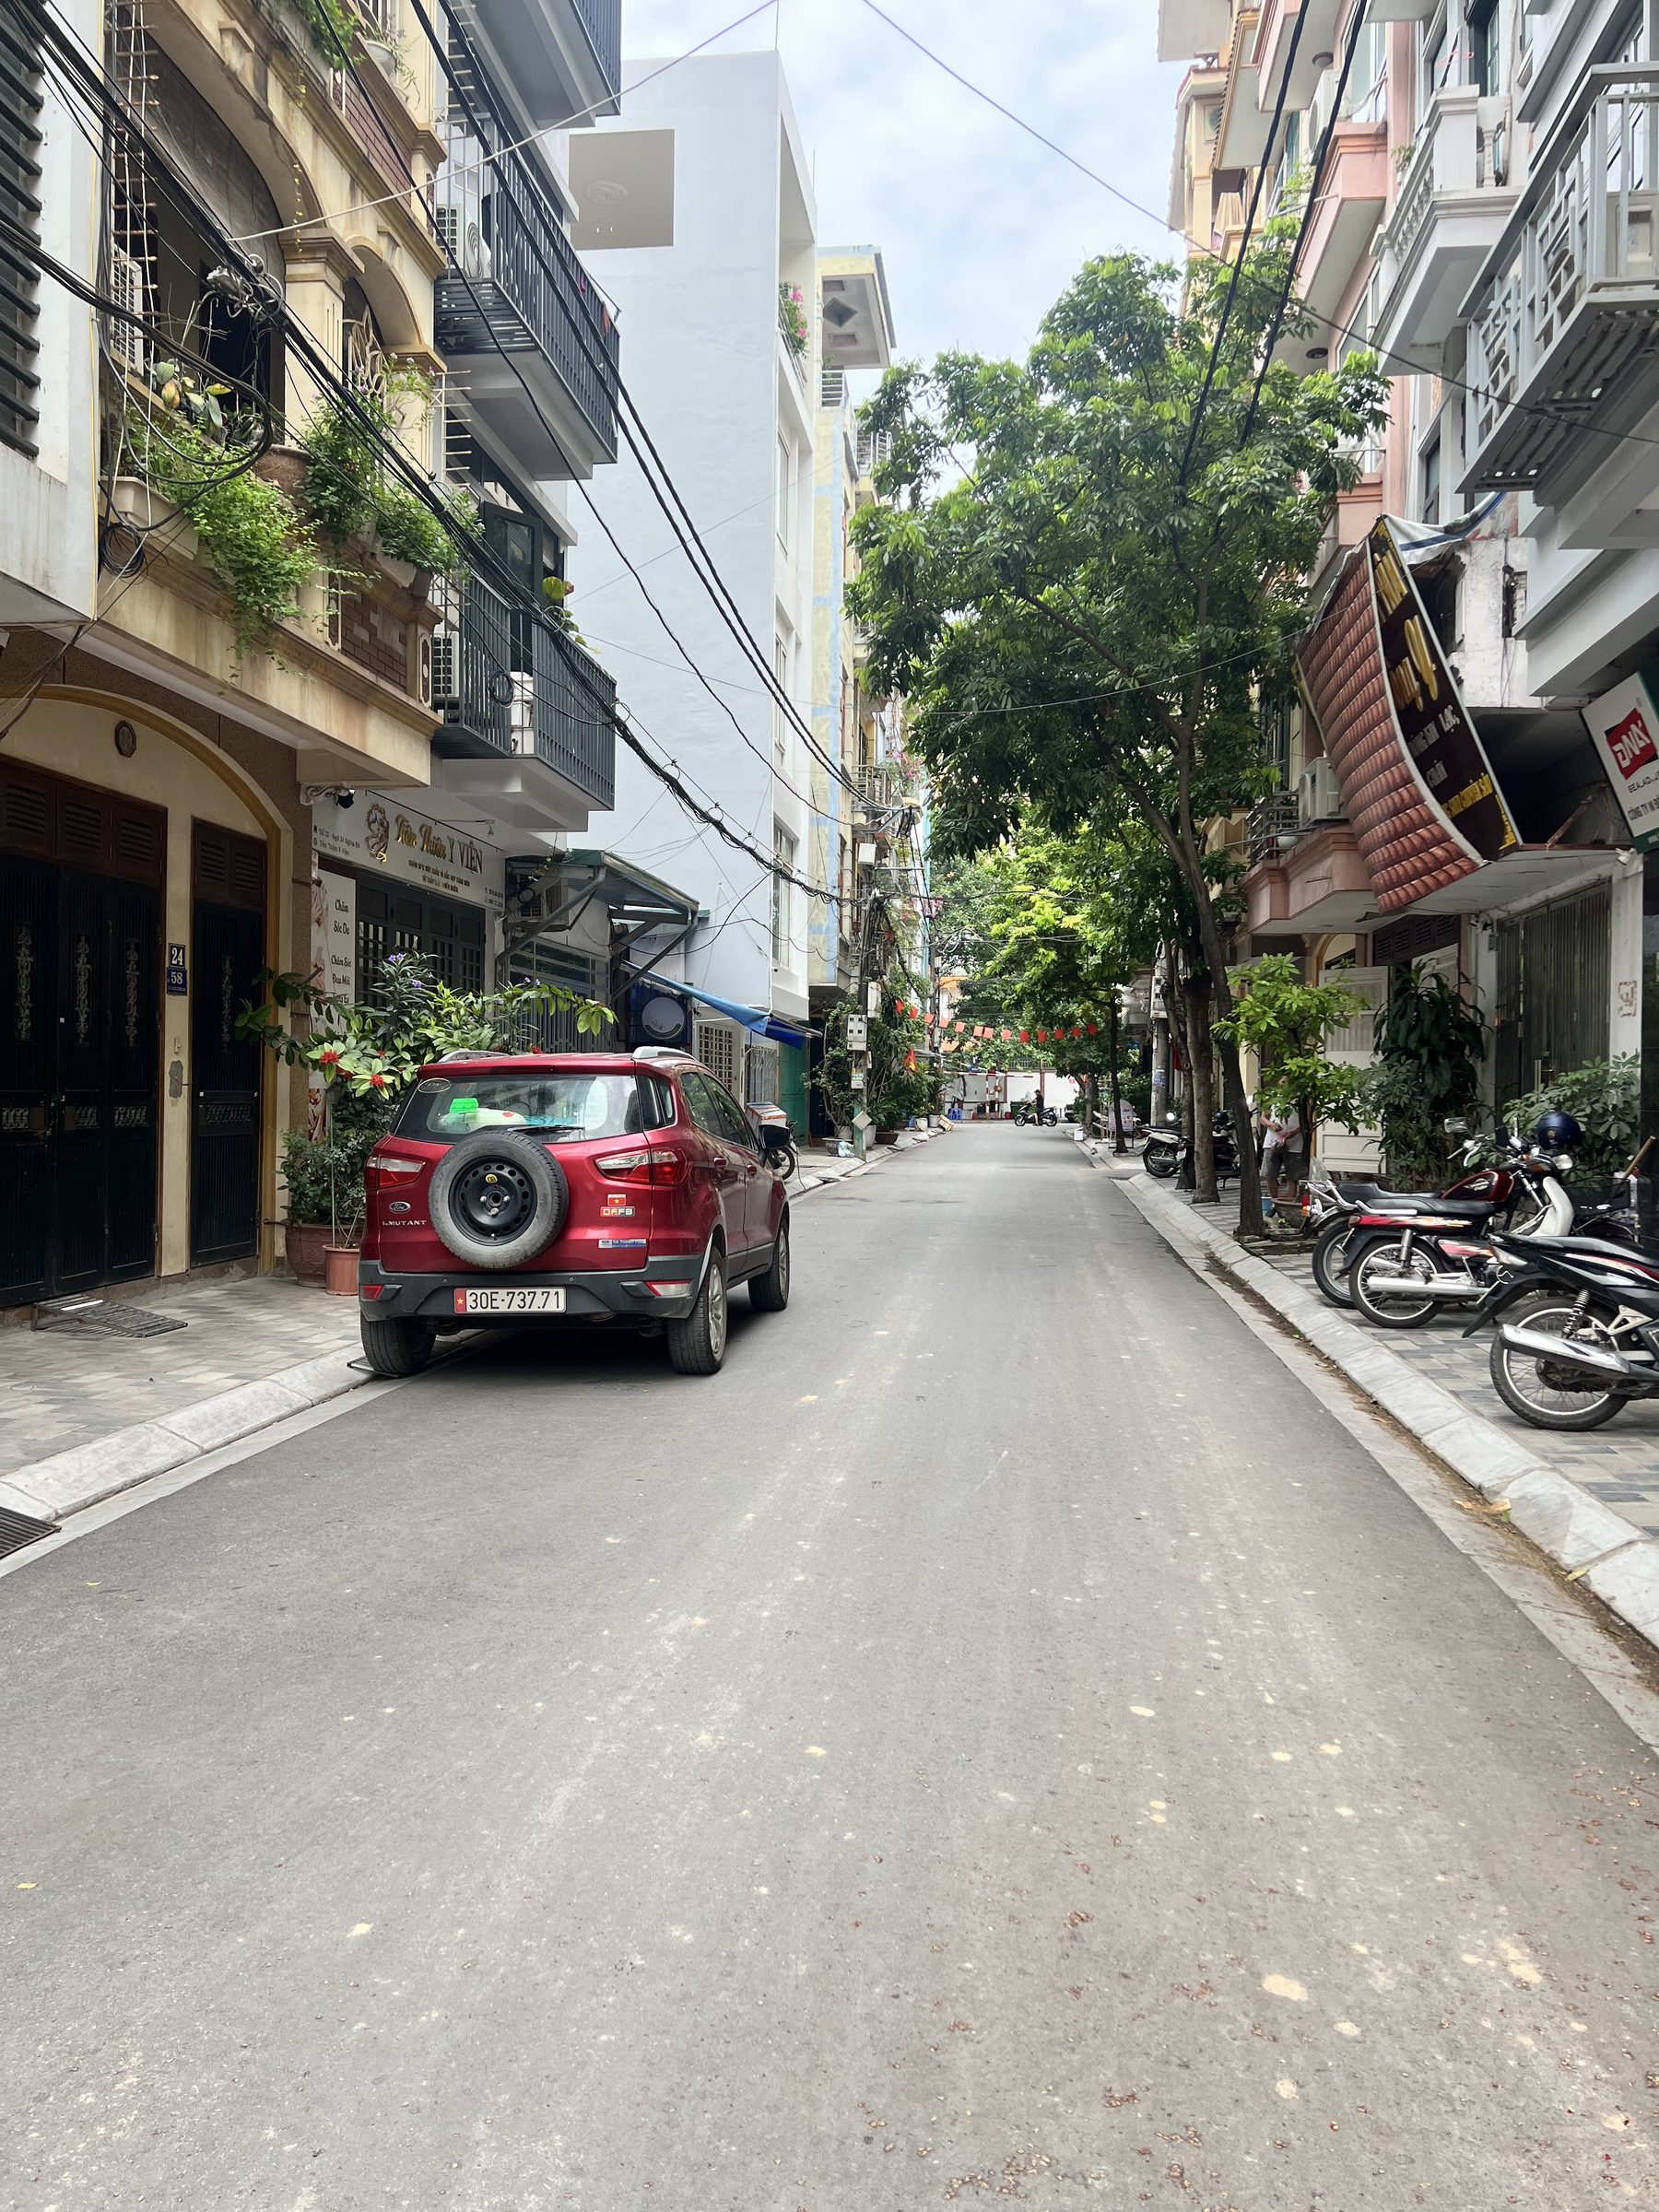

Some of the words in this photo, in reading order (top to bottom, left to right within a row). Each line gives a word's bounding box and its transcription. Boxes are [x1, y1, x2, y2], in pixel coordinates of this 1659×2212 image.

[447, 836, 455, 865] Y
[457, 841, 483, 875] VIỆN
[171, 947, 183, 966] 24
[171, 971, 183, 985] 58
[469, 1290, 559, 1310] 30E-737.71
